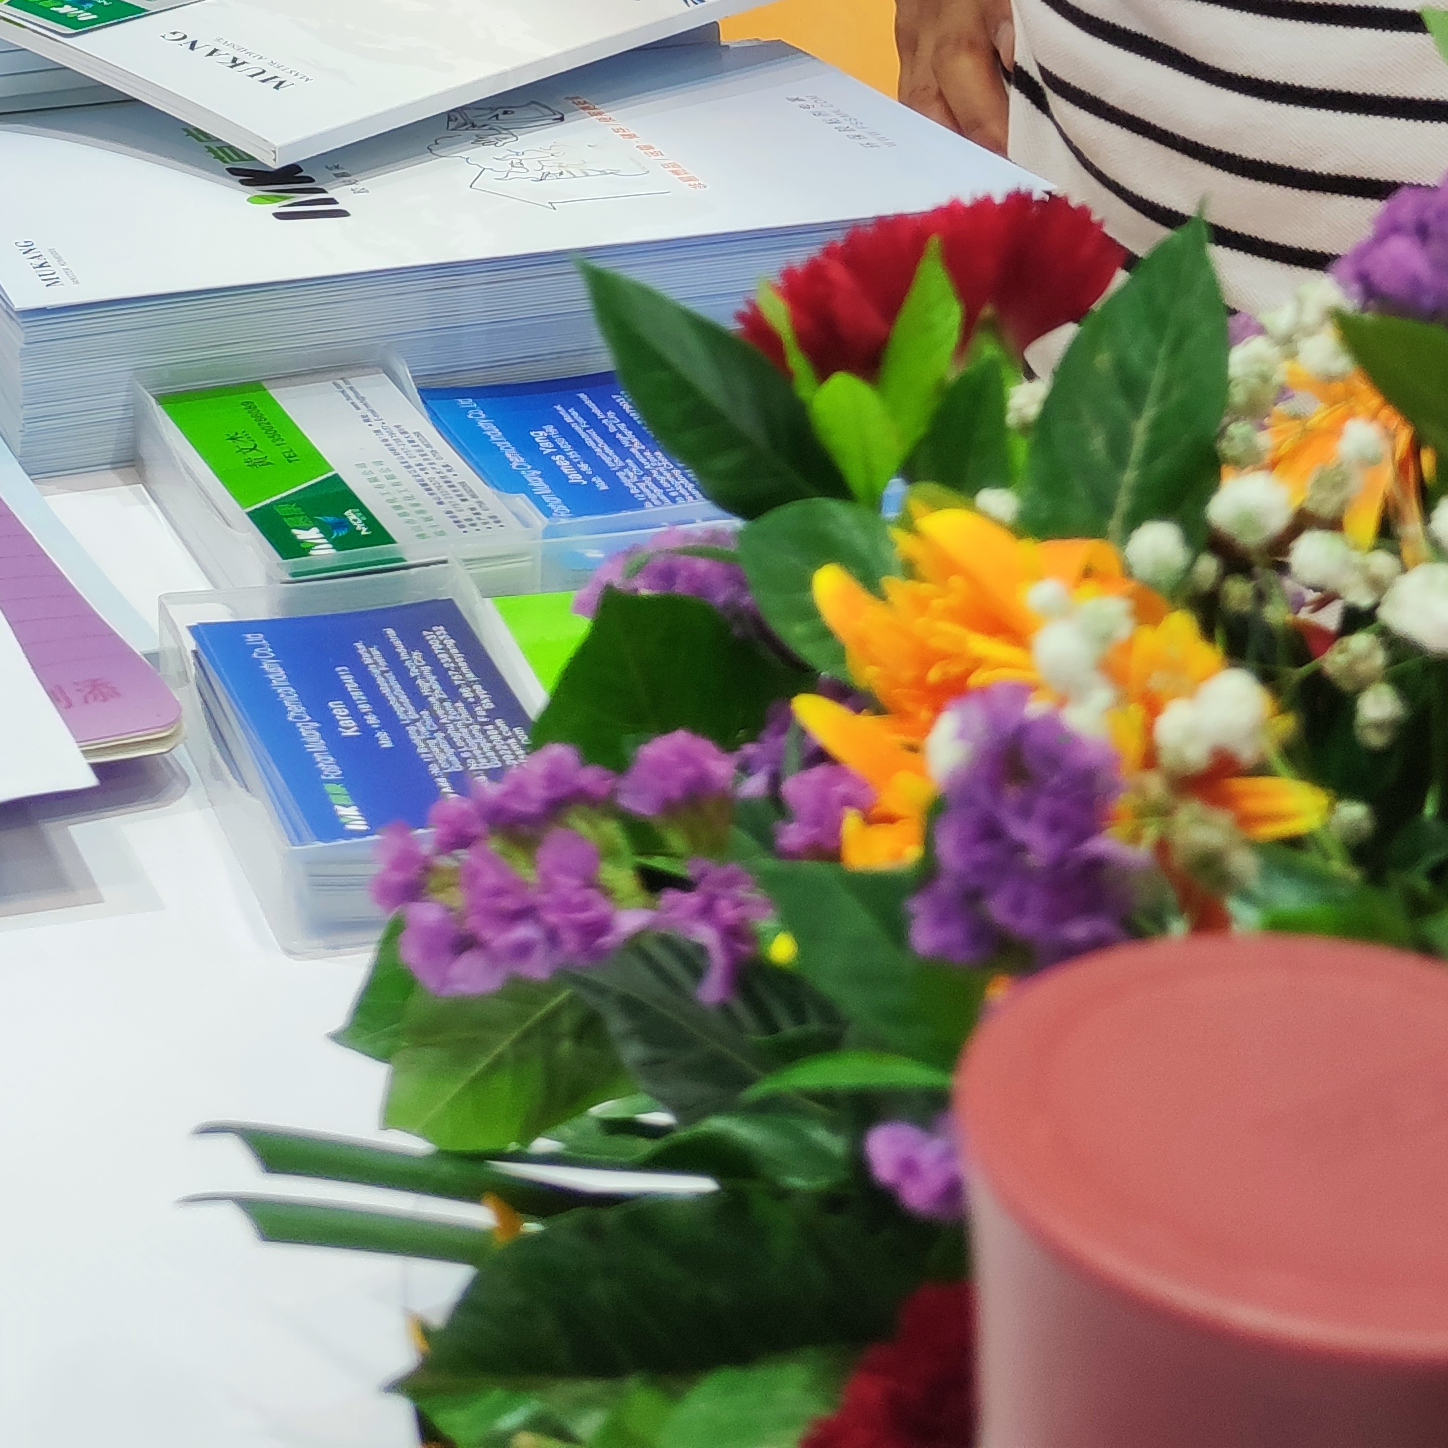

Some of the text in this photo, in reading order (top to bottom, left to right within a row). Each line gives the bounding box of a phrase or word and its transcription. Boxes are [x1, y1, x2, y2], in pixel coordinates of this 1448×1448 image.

[160, 30, 295, 91] MUKANG
[267, 59, 314, 84] MASTER
[14, 238, 65, 288] MUKANG
[530, 431, 587, 485] James Yang
[328, 701, 361, 736] Karen
